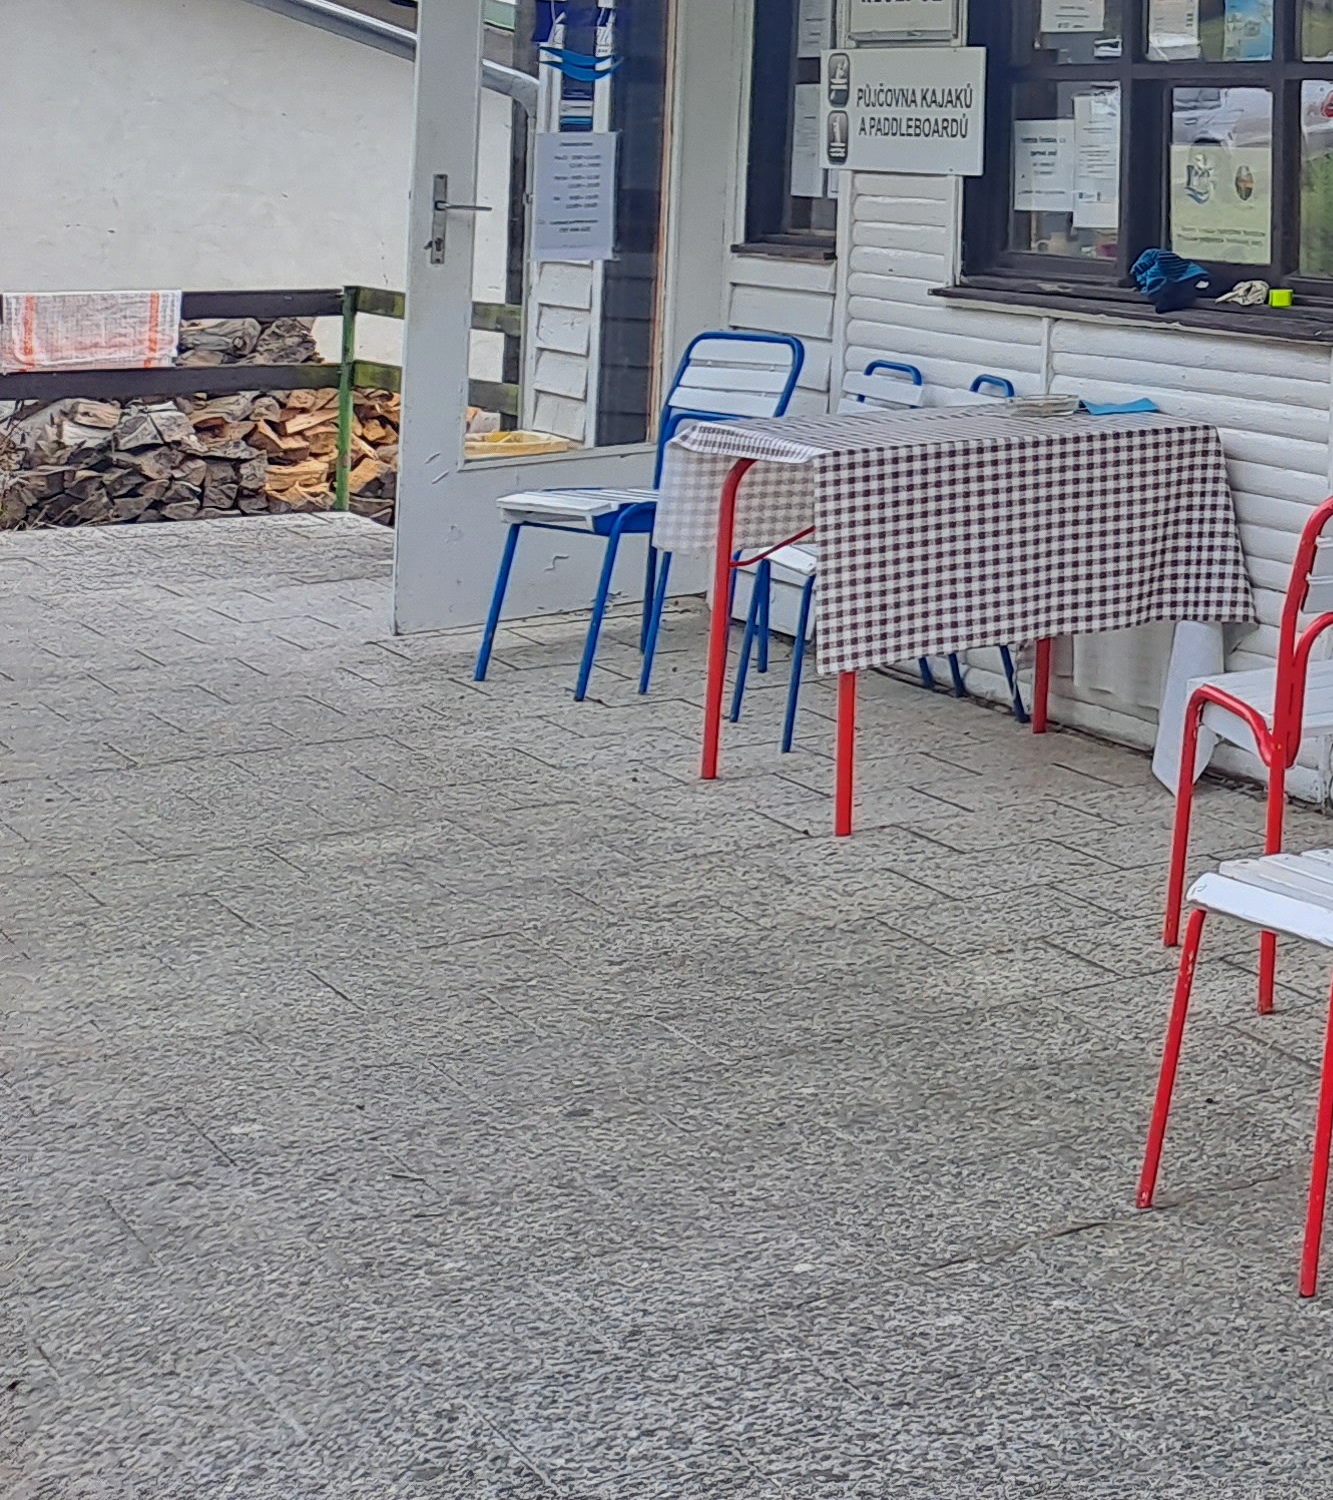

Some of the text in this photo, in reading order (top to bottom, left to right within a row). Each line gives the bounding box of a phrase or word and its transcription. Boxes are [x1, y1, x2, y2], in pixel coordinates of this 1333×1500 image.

[857, 83, 973, 109] PŮJČOVNA KAJAKŮ
[858, 113, 969, 139] A PADDLEBOARDŮ
